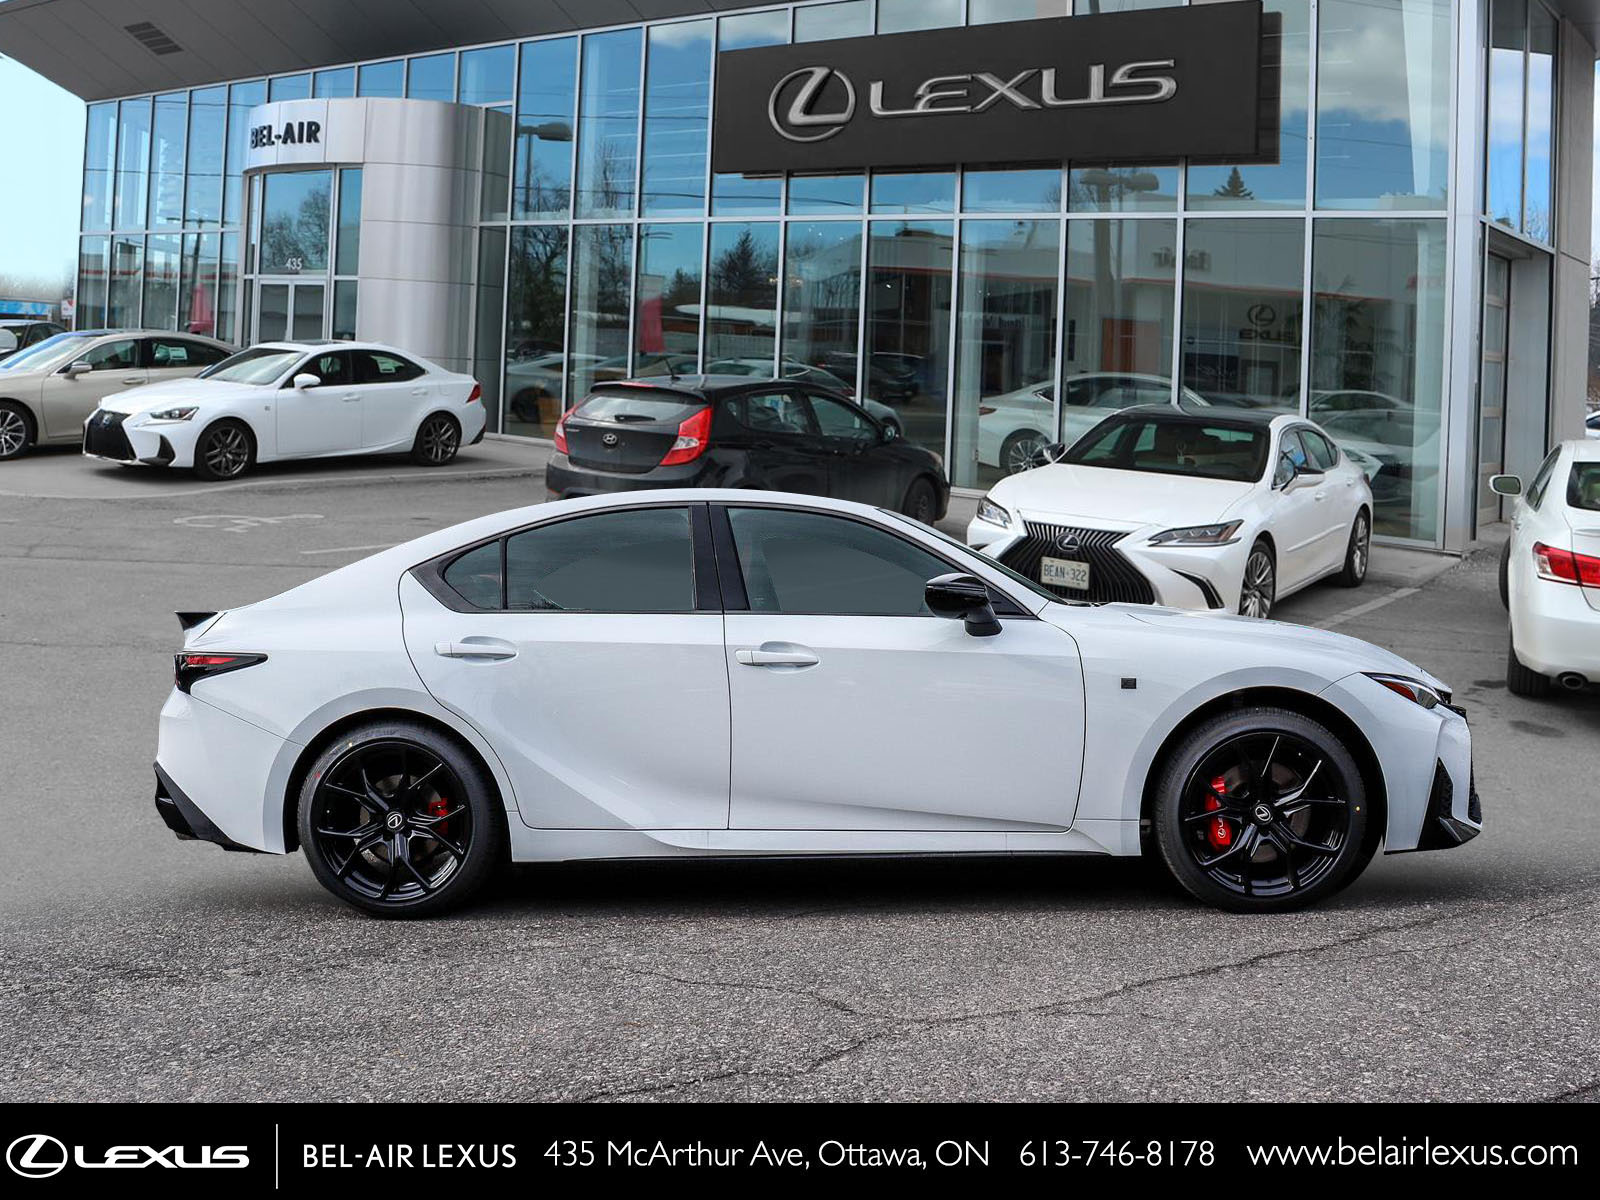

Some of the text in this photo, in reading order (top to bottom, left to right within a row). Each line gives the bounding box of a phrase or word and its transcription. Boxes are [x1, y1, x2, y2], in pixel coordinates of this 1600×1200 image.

[869, 59, 1177, 118] LEXUS
[251, 121, 320, 149] BEL-AIR
[286, 257, 302, 270] 435
